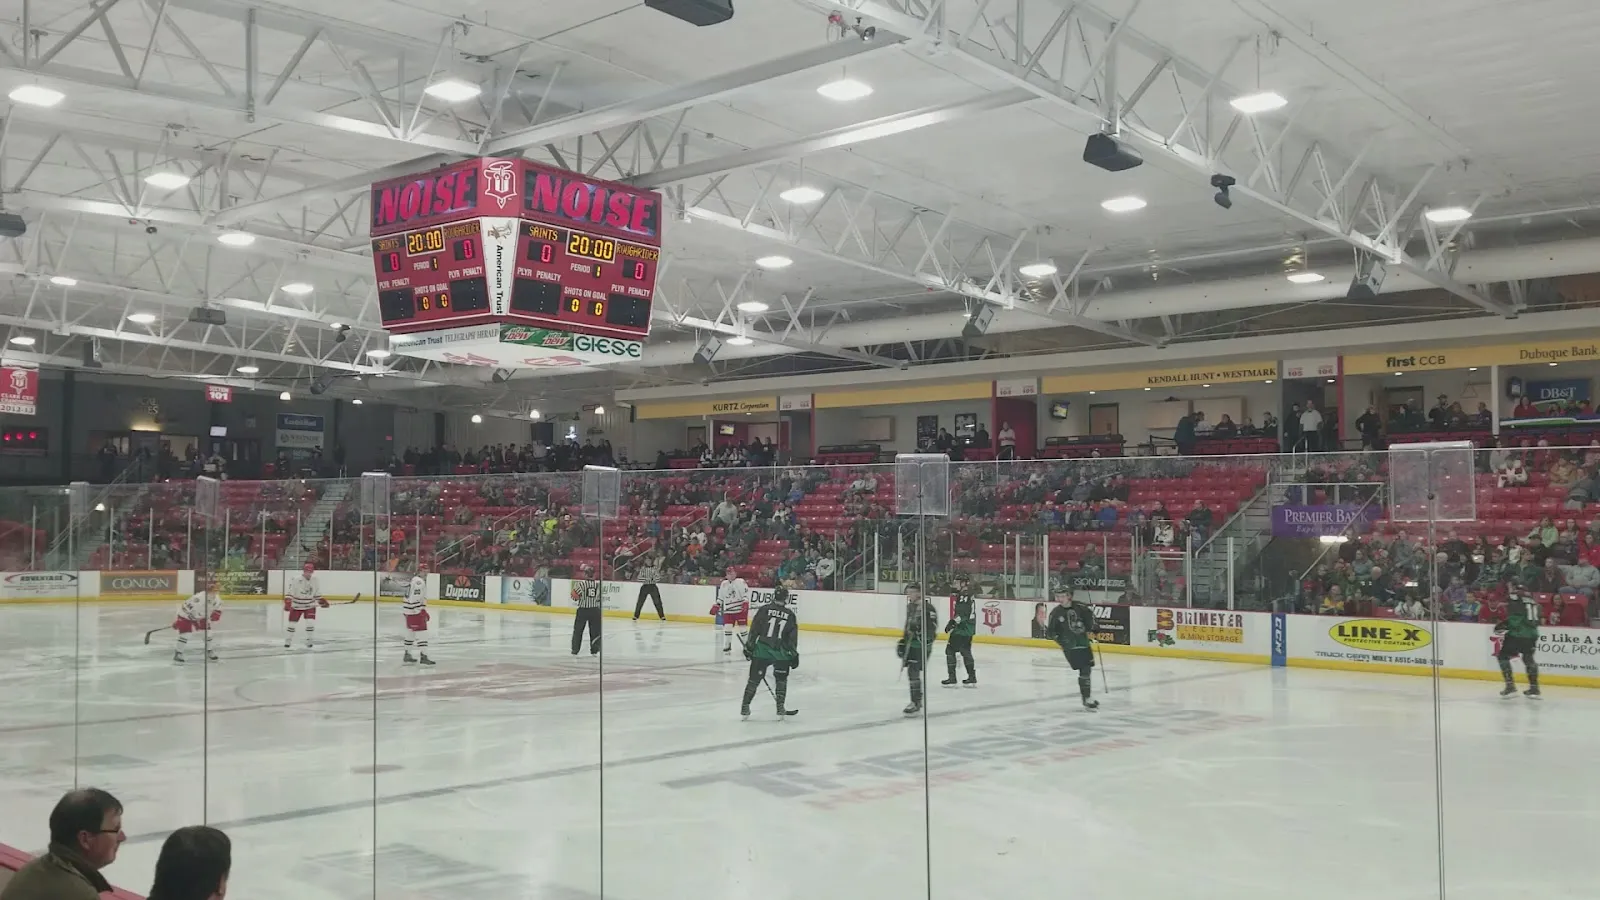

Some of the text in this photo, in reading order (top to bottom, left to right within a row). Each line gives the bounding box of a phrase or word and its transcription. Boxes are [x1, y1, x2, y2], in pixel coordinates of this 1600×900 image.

[377, 168, 476, 225] NOISE
[531, 174, 654, 233] NOISE
[529, 226, 558, 240] SAINTS
[378, 239, 399, 250] SAINTS
[408, 230, 442, 252] 20:00
[569, 234, 613, 259] 20:00
[463, 240, 473, 259] 0
[541, 244, 552, 262] 0
[616, 243, 659, 260] ROUGHRIDER
[390, 253, 398, 270] 0
[413, 260, 430, 270] PERIOD
[570, 263, 591, 273] PERIOD
[449, 266, 482, 279] PLYR PENALTY
[517, 267, 561, 281] PLYR PENALTY
[635, 262, 645, 279] 0
[392, 278, 409, 287] PENALTY
[496, 245, 504, 314] American Trust
[414, 283, 448, 294] SHOTS ON GOAL
[564, 286, 606, 300] SHOTS ON GOAL
[611, 284, 650, 297] PLYR PENALTY
[423, 296, 430, 310] 0
[441, 294, 448, 307] 0
[571, 298, 579, 312] 0
[594, 302, 603, 316] 0
[428, 336, 442, 344] Trust
[575, 336, 641, 357] GIESE
[1519, 345, 1599, 360] Dubuque Bank
[1386, 355, 1446, 368] first CCB
[1148, 368, 1276, 384] KENDALL HUNT WESTMARK
[209, 391, 229, 400] 101
[1540, 387, 1576, 400] DB&T
[712, 403, 739, 411] KURTZ
[1284, 509, 1333, 522] PREMIER
[112, 578, 170, 589] CONLON
[445, 584, 479, 600] Dupaco
[588, 588, 596, 596] 16
[751, 591, 798, 605] DUBE
[767, 617, 787, 638] 11
[1338, 625, 1421, 642] LINE-X
[1207, 635, 1239, 643] STORAGE
[1552, 634, 1579, 643] Like
[1584, 635, 1592, 644] A
[1537, 644, 1569, 653] HOOL
